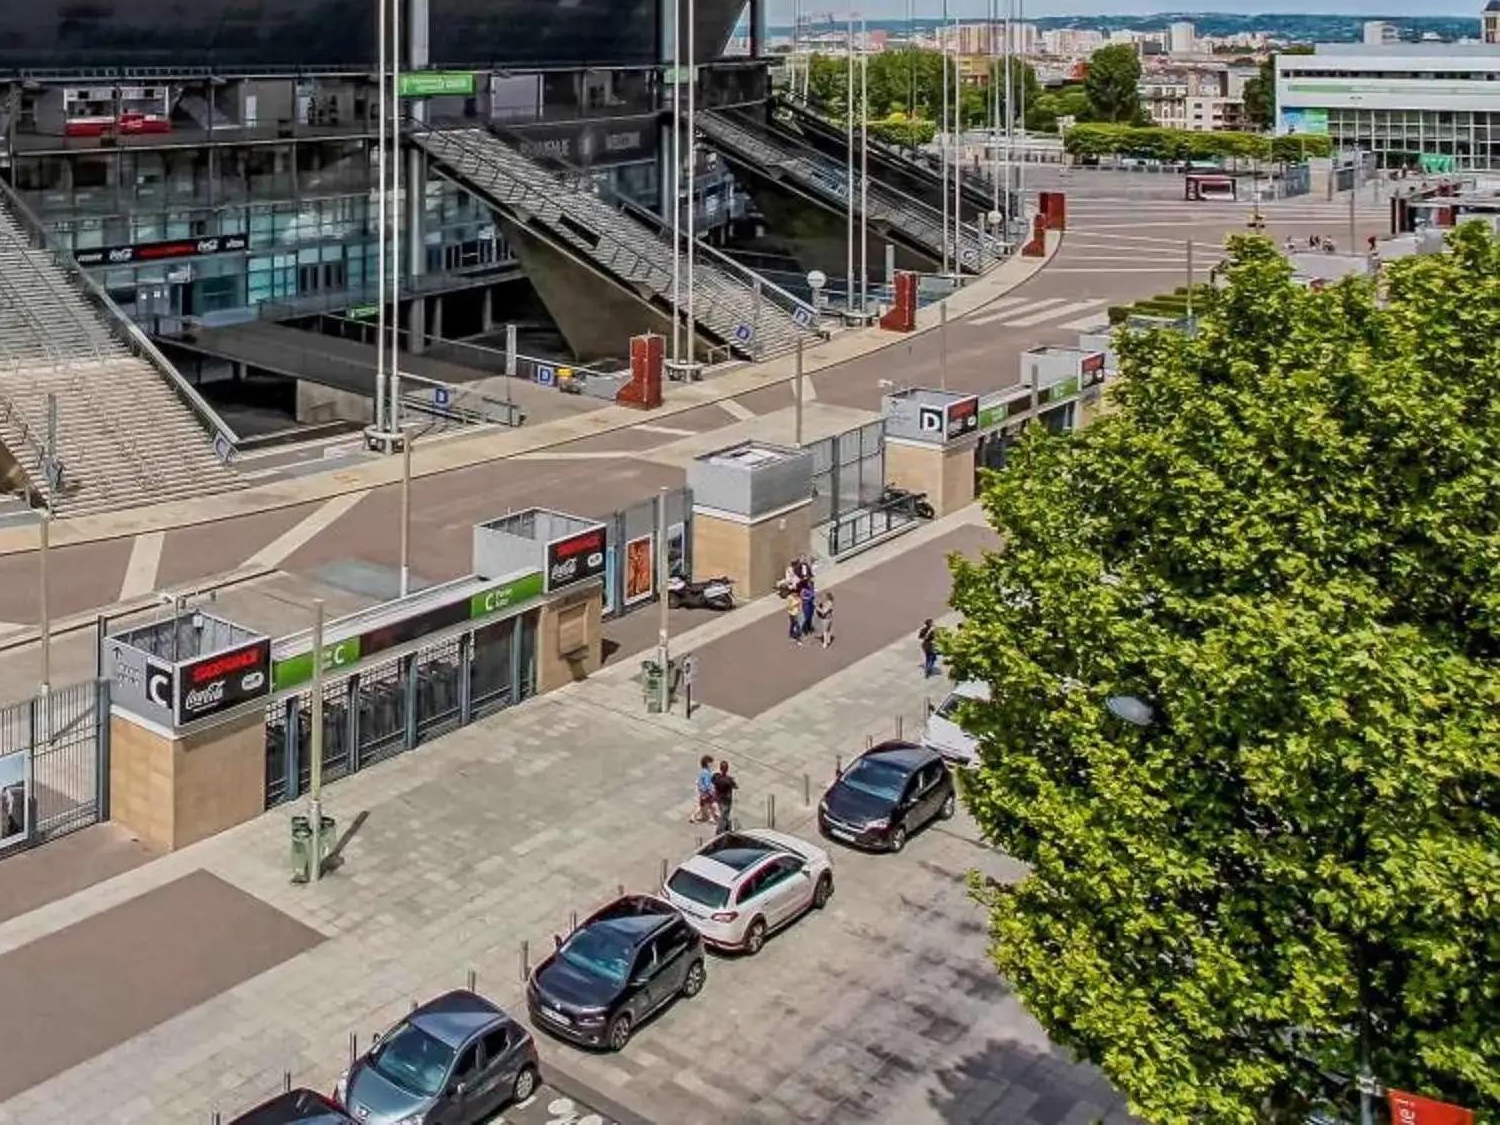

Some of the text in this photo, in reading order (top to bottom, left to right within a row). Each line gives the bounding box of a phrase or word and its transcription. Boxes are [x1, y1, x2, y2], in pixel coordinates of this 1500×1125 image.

[923, 412, 940, 431] D
[485, 593, 494, 610] C
[334, 644, 345, 664] C
[150, 674, 169, 707] C
